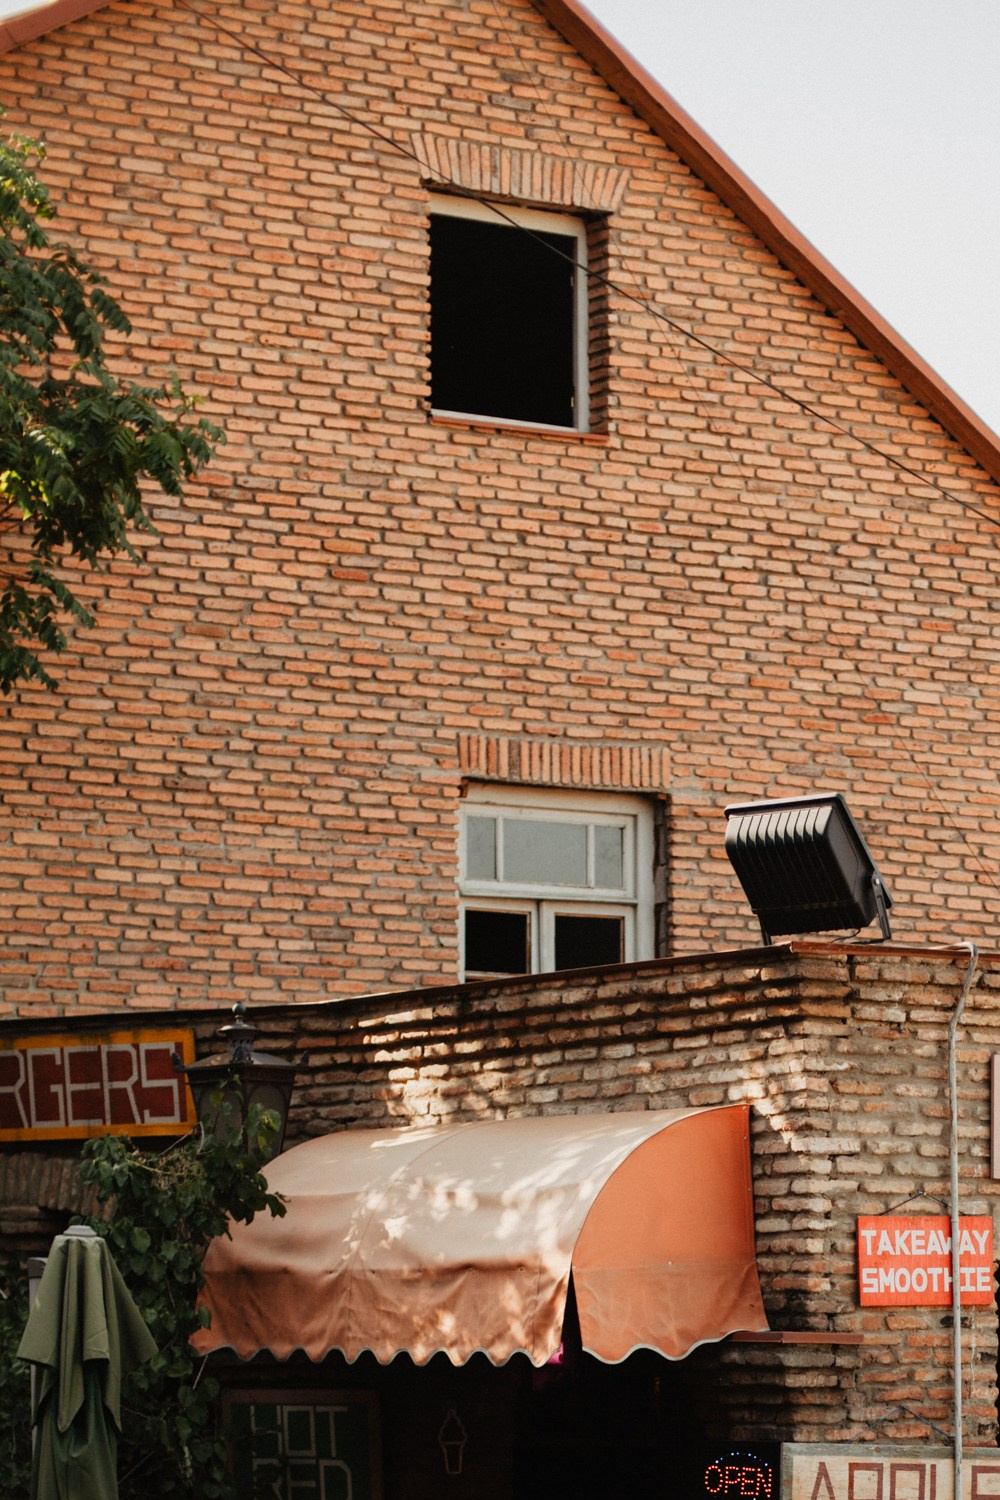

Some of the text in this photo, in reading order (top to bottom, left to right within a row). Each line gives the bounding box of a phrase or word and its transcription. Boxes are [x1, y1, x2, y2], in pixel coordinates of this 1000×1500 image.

[861, 1229, 990, 1256] TAKEAWAY
[862, 1267, 991, 1293] SMOOTHIE
[704, 1465, 772, 1498] OPEN
